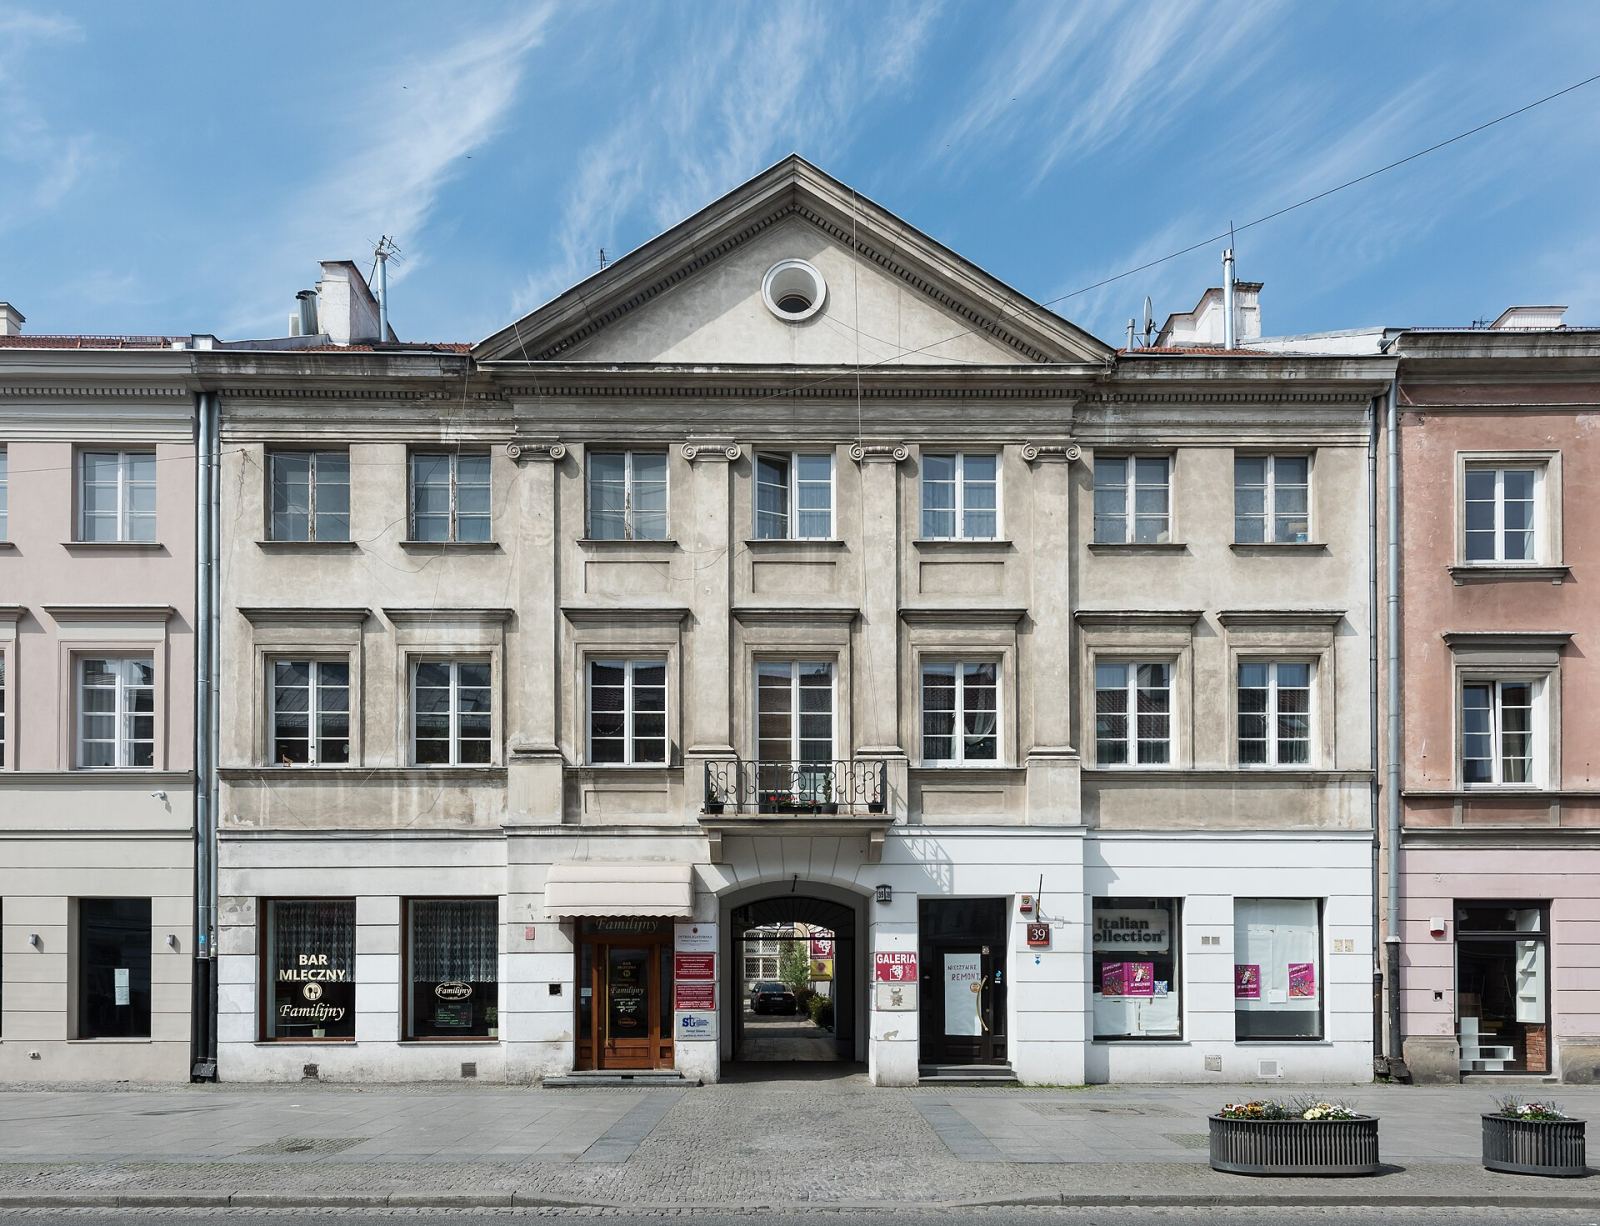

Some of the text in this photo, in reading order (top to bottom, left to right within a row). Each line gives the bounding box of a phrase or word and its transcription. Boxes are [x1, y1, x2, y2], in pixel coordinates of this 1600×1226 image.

[1097, 917, 1149, 930] Italian
[1031, 928, 1046, 941] 39
[1092, 929, 1162, 943] ollection
[299, 954, 328, 966] BAR
[876, 953, 916, 964] GALERIA
[279, 969, 346, 981] MLECZNY
[279, 1002, 345, 1021] Familijny
